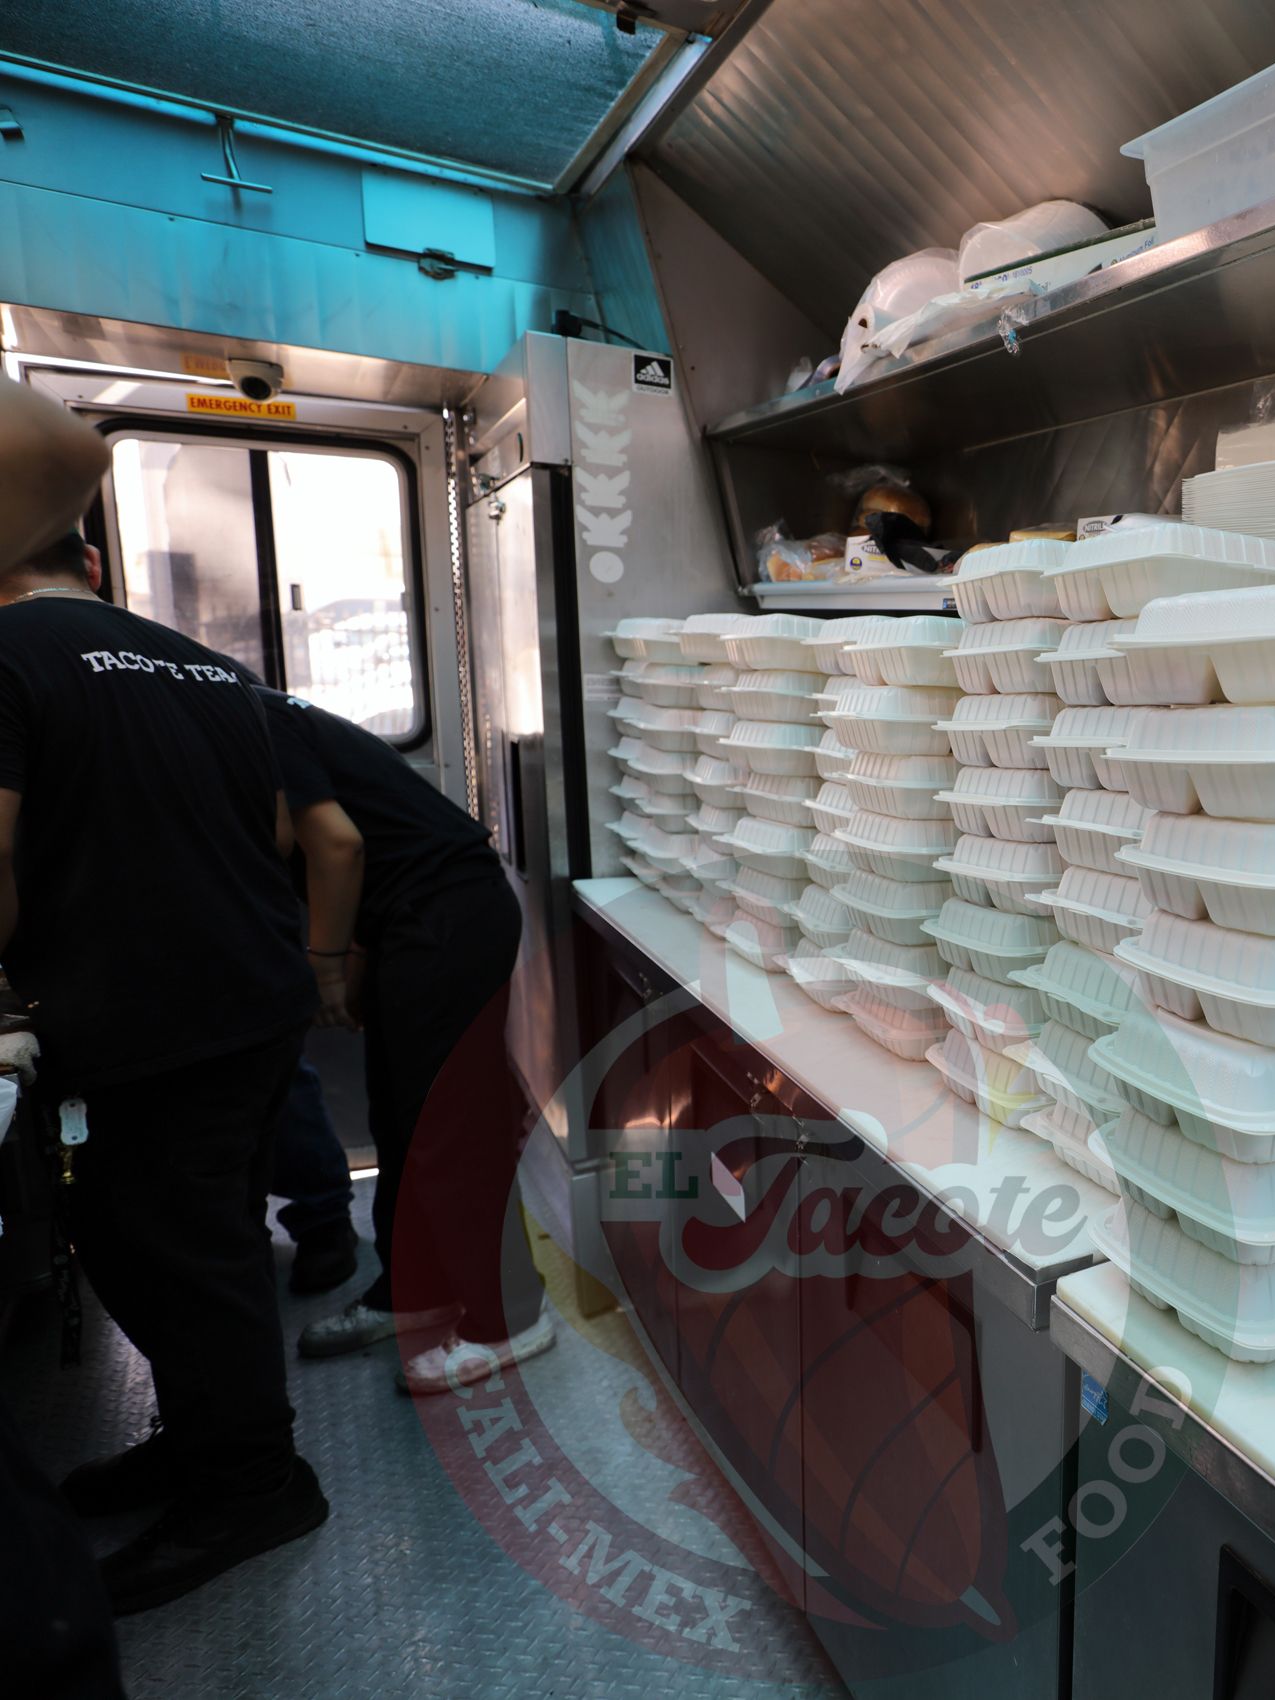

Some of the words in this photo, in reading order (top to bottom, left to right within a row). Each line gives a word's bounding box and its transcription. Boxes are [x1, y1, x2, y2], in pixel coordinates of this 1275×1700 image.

[636, 373, 669, 385] adidas
[189, 396, 262, 413] EMERGENCY
[267, 404, 291, 416] EXIT
[1085, 521, 1104, 532] NITRIL
